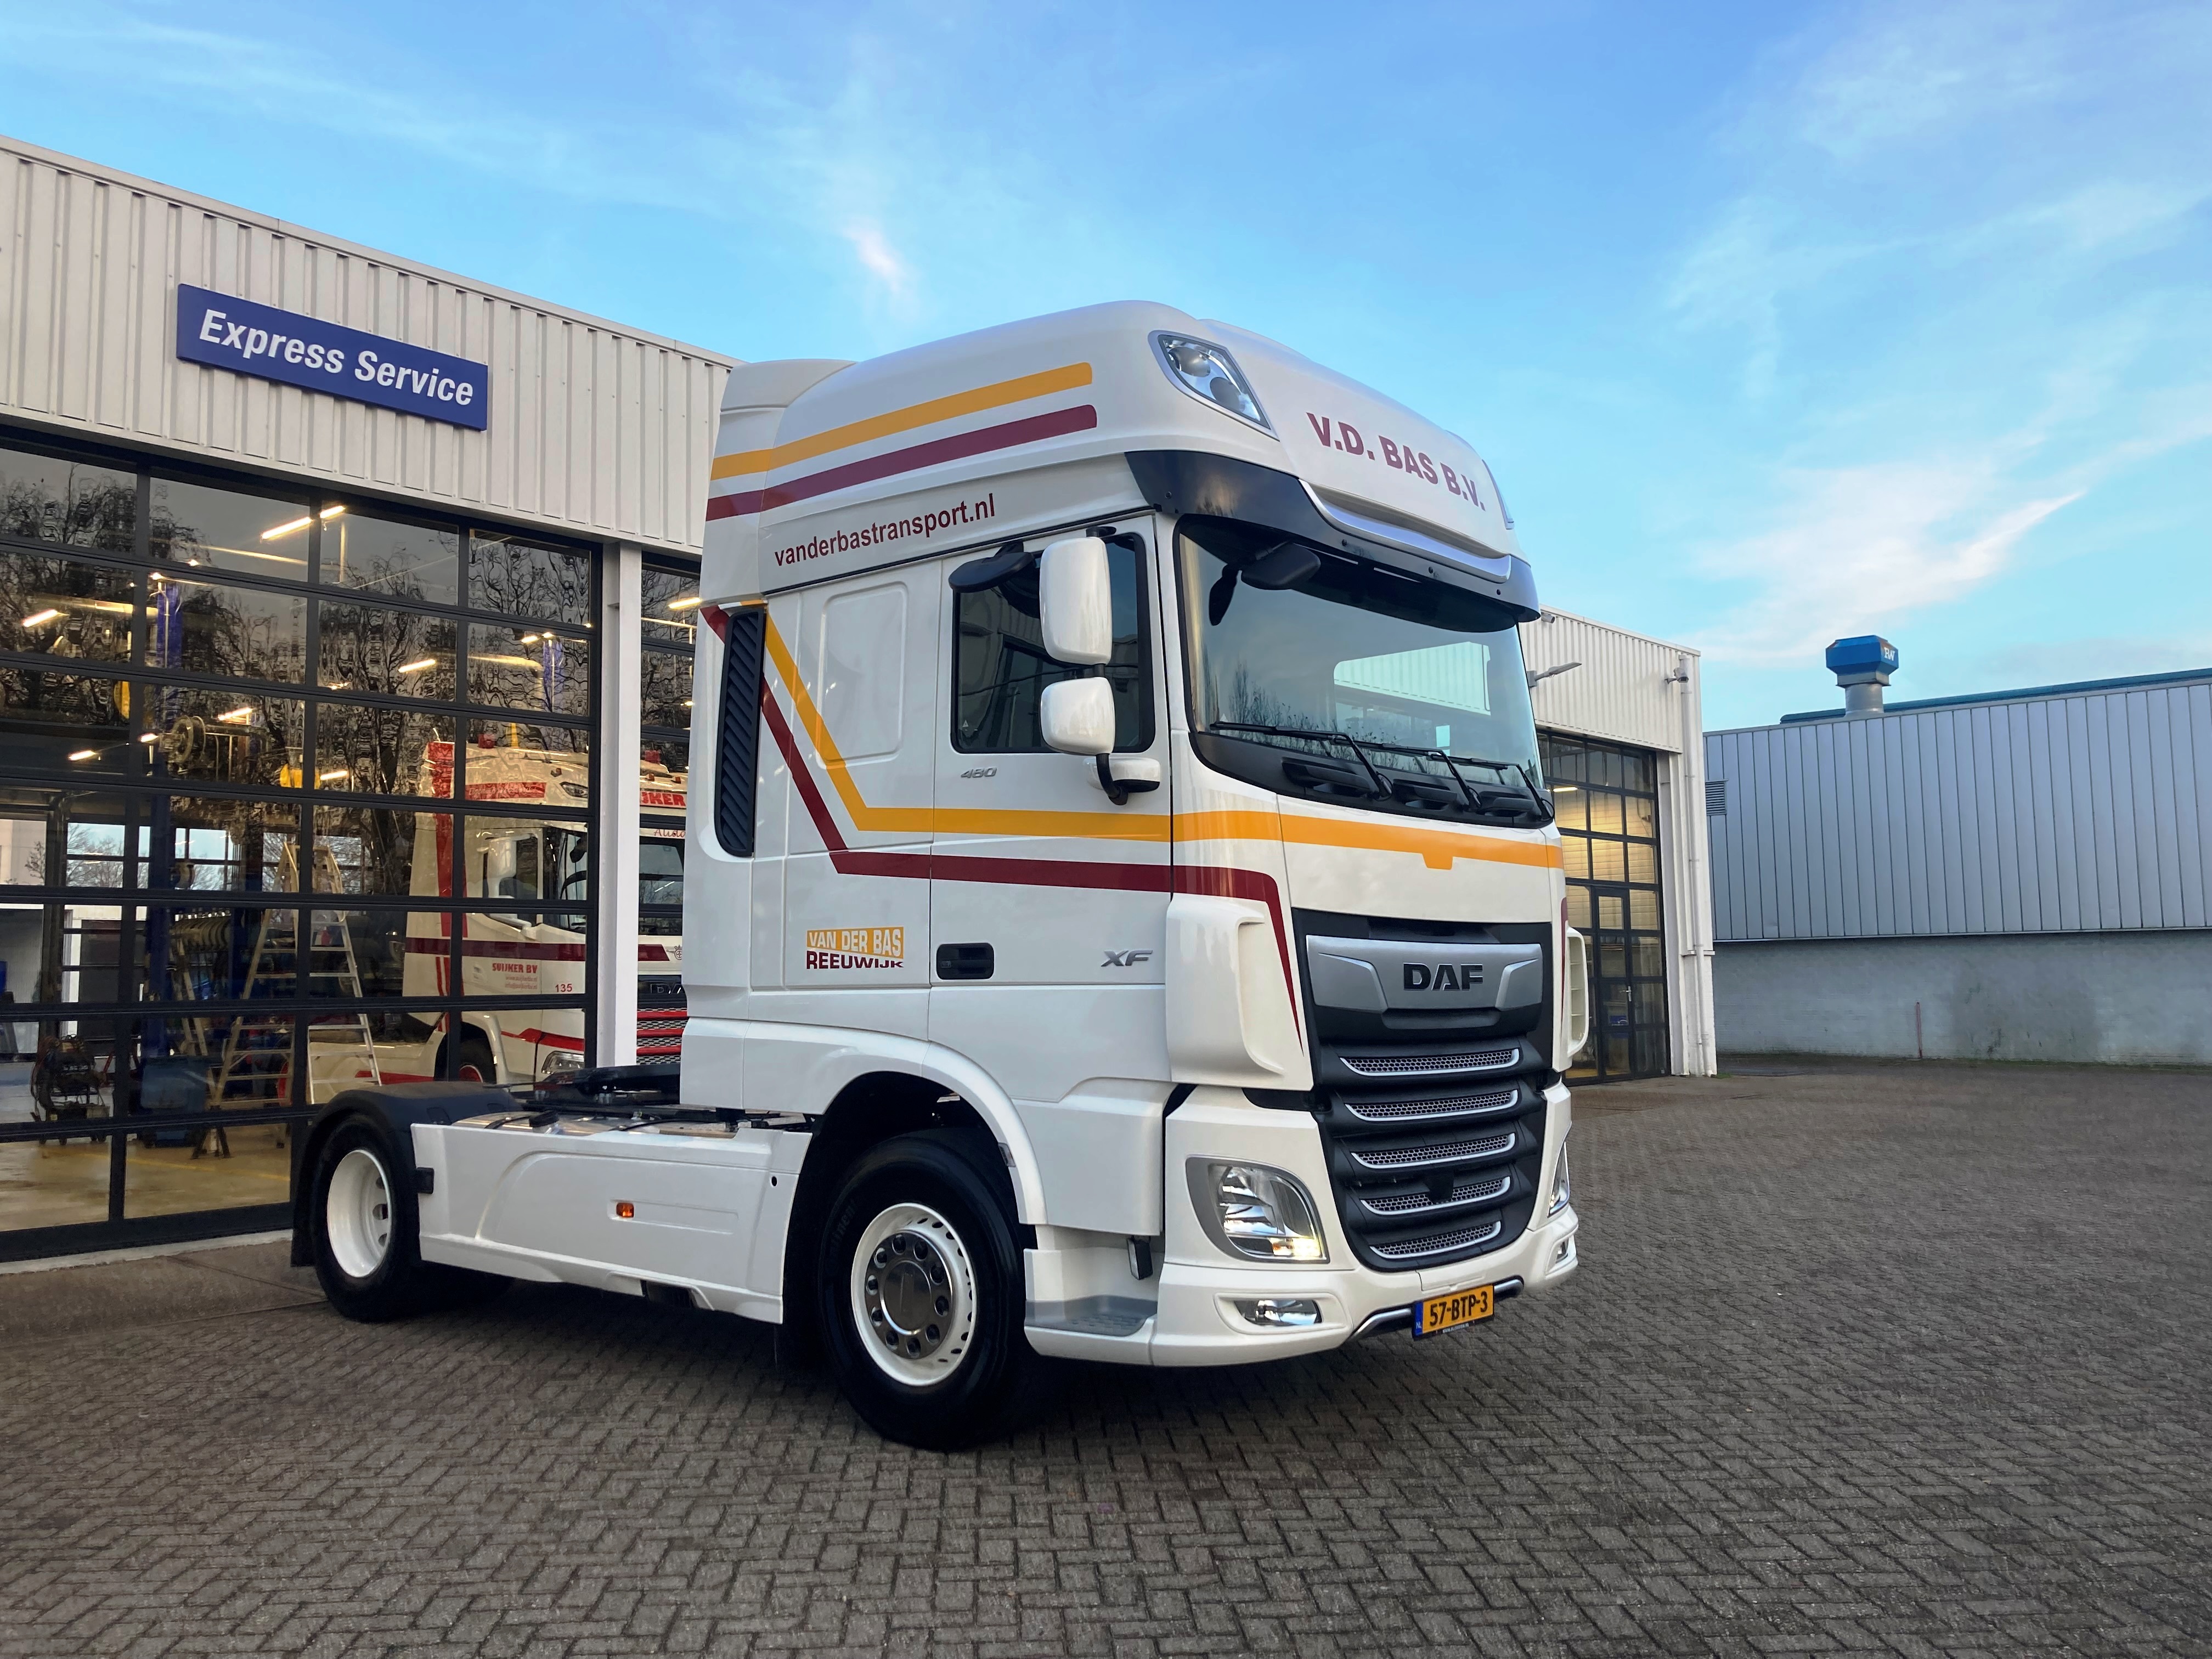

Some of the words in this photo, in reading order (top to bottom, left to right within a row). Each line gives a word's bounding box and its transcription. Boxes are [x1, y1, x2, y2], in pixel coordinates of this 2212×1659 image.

[199, 308, 345, 373] Express
[354, 350, 473, 406] Service
[1306, 412, 1375, 460] V.D.
[1378, 435, 1438, 484] BAS
[1440, 462, 1486, 511] B.V.
[775, 493, 995, 566] vanderbastransport.nl
[641, 792, 686, 806] JKER
[809, 931, 836, 949] VAN
[842, 930, 868, 953] DER
[873, 929, 901, 957] BAS
[492, 963, 524, 973] SUIJKER
[526, 964, 538, 973] BV
[806, 951, 904, 969] REEUWIJK
[1101, 950, 1153, 967] XF
[555, 984, 572, 992] 135
[1403, 962, 1483, 991] DAF
[1430, 1291, 1488, 1326] 57-BTP-3
